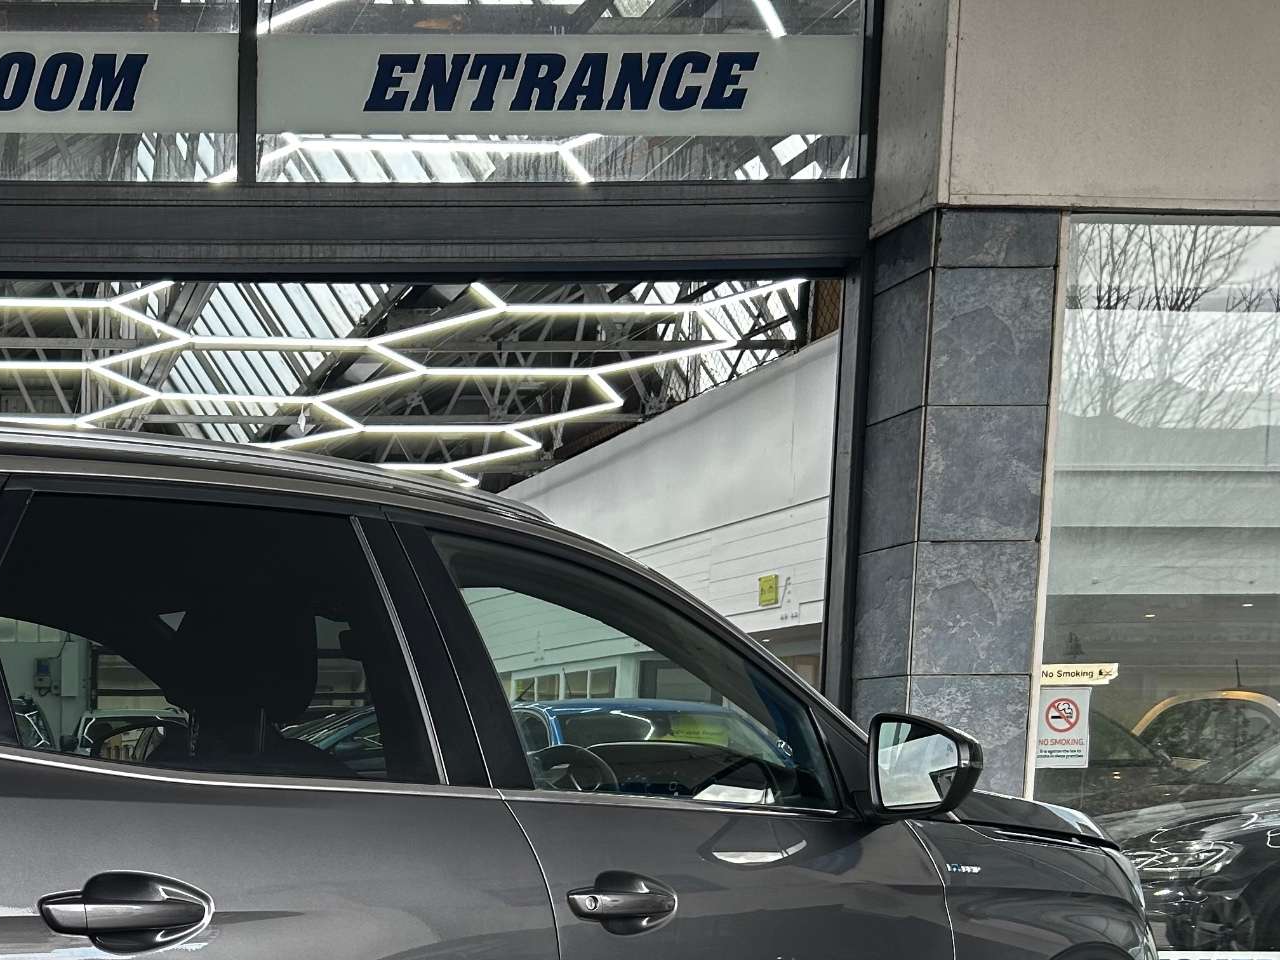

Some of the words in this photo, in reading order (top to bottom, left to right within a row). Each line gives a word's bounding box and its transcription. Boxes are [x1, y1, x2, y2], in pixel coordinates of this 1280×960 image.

[362, 50, 760, 112] ENTRANCE
[1041, 670, 1054, 678] No
[1056, 670, 1094, 678] Smoking
[1038, 738, 1049, 746] NO
[1049, 738, 1084, 746] SMOKING
